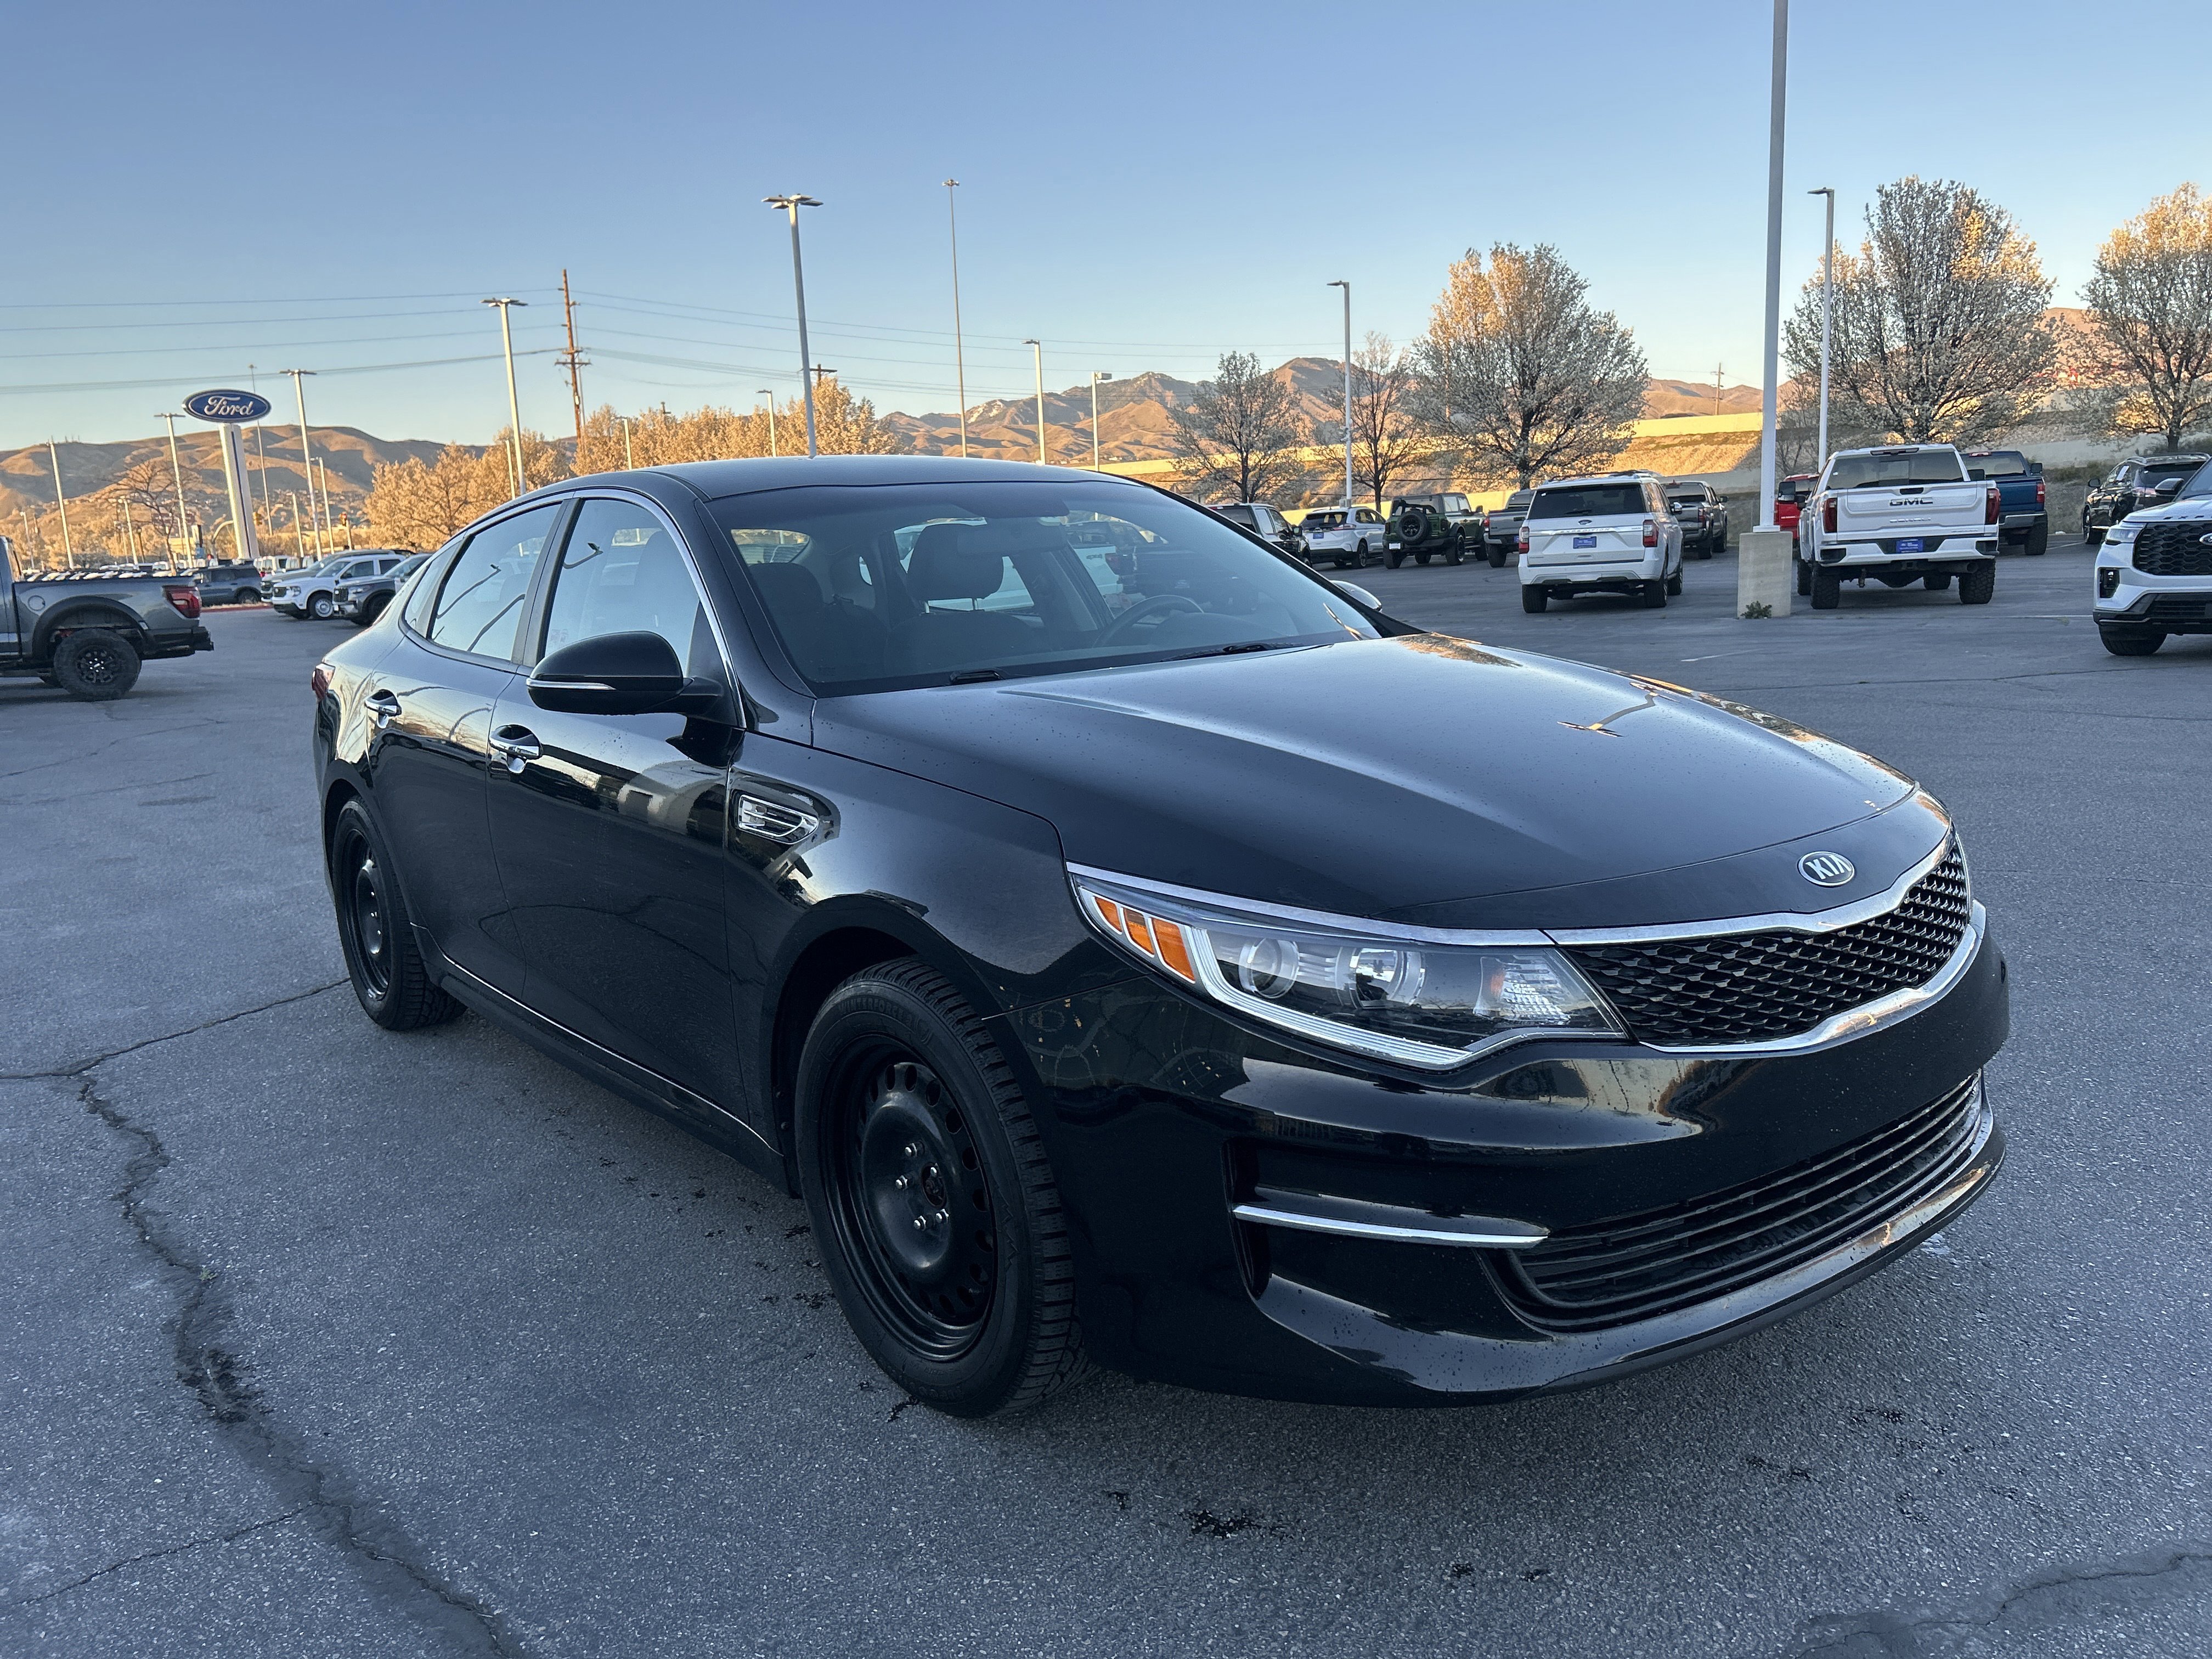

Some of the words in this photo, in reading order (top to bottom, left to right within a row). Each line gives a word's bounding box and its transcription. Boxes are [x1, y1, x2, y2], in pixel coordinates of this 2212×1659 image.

[204, 395, 254, 416] Ford
[1889, 496, 1933, 506] GMC
[1805, 854, 1852, 880] KIA
[838, 997, 904, 1019] WINTERFORCE
